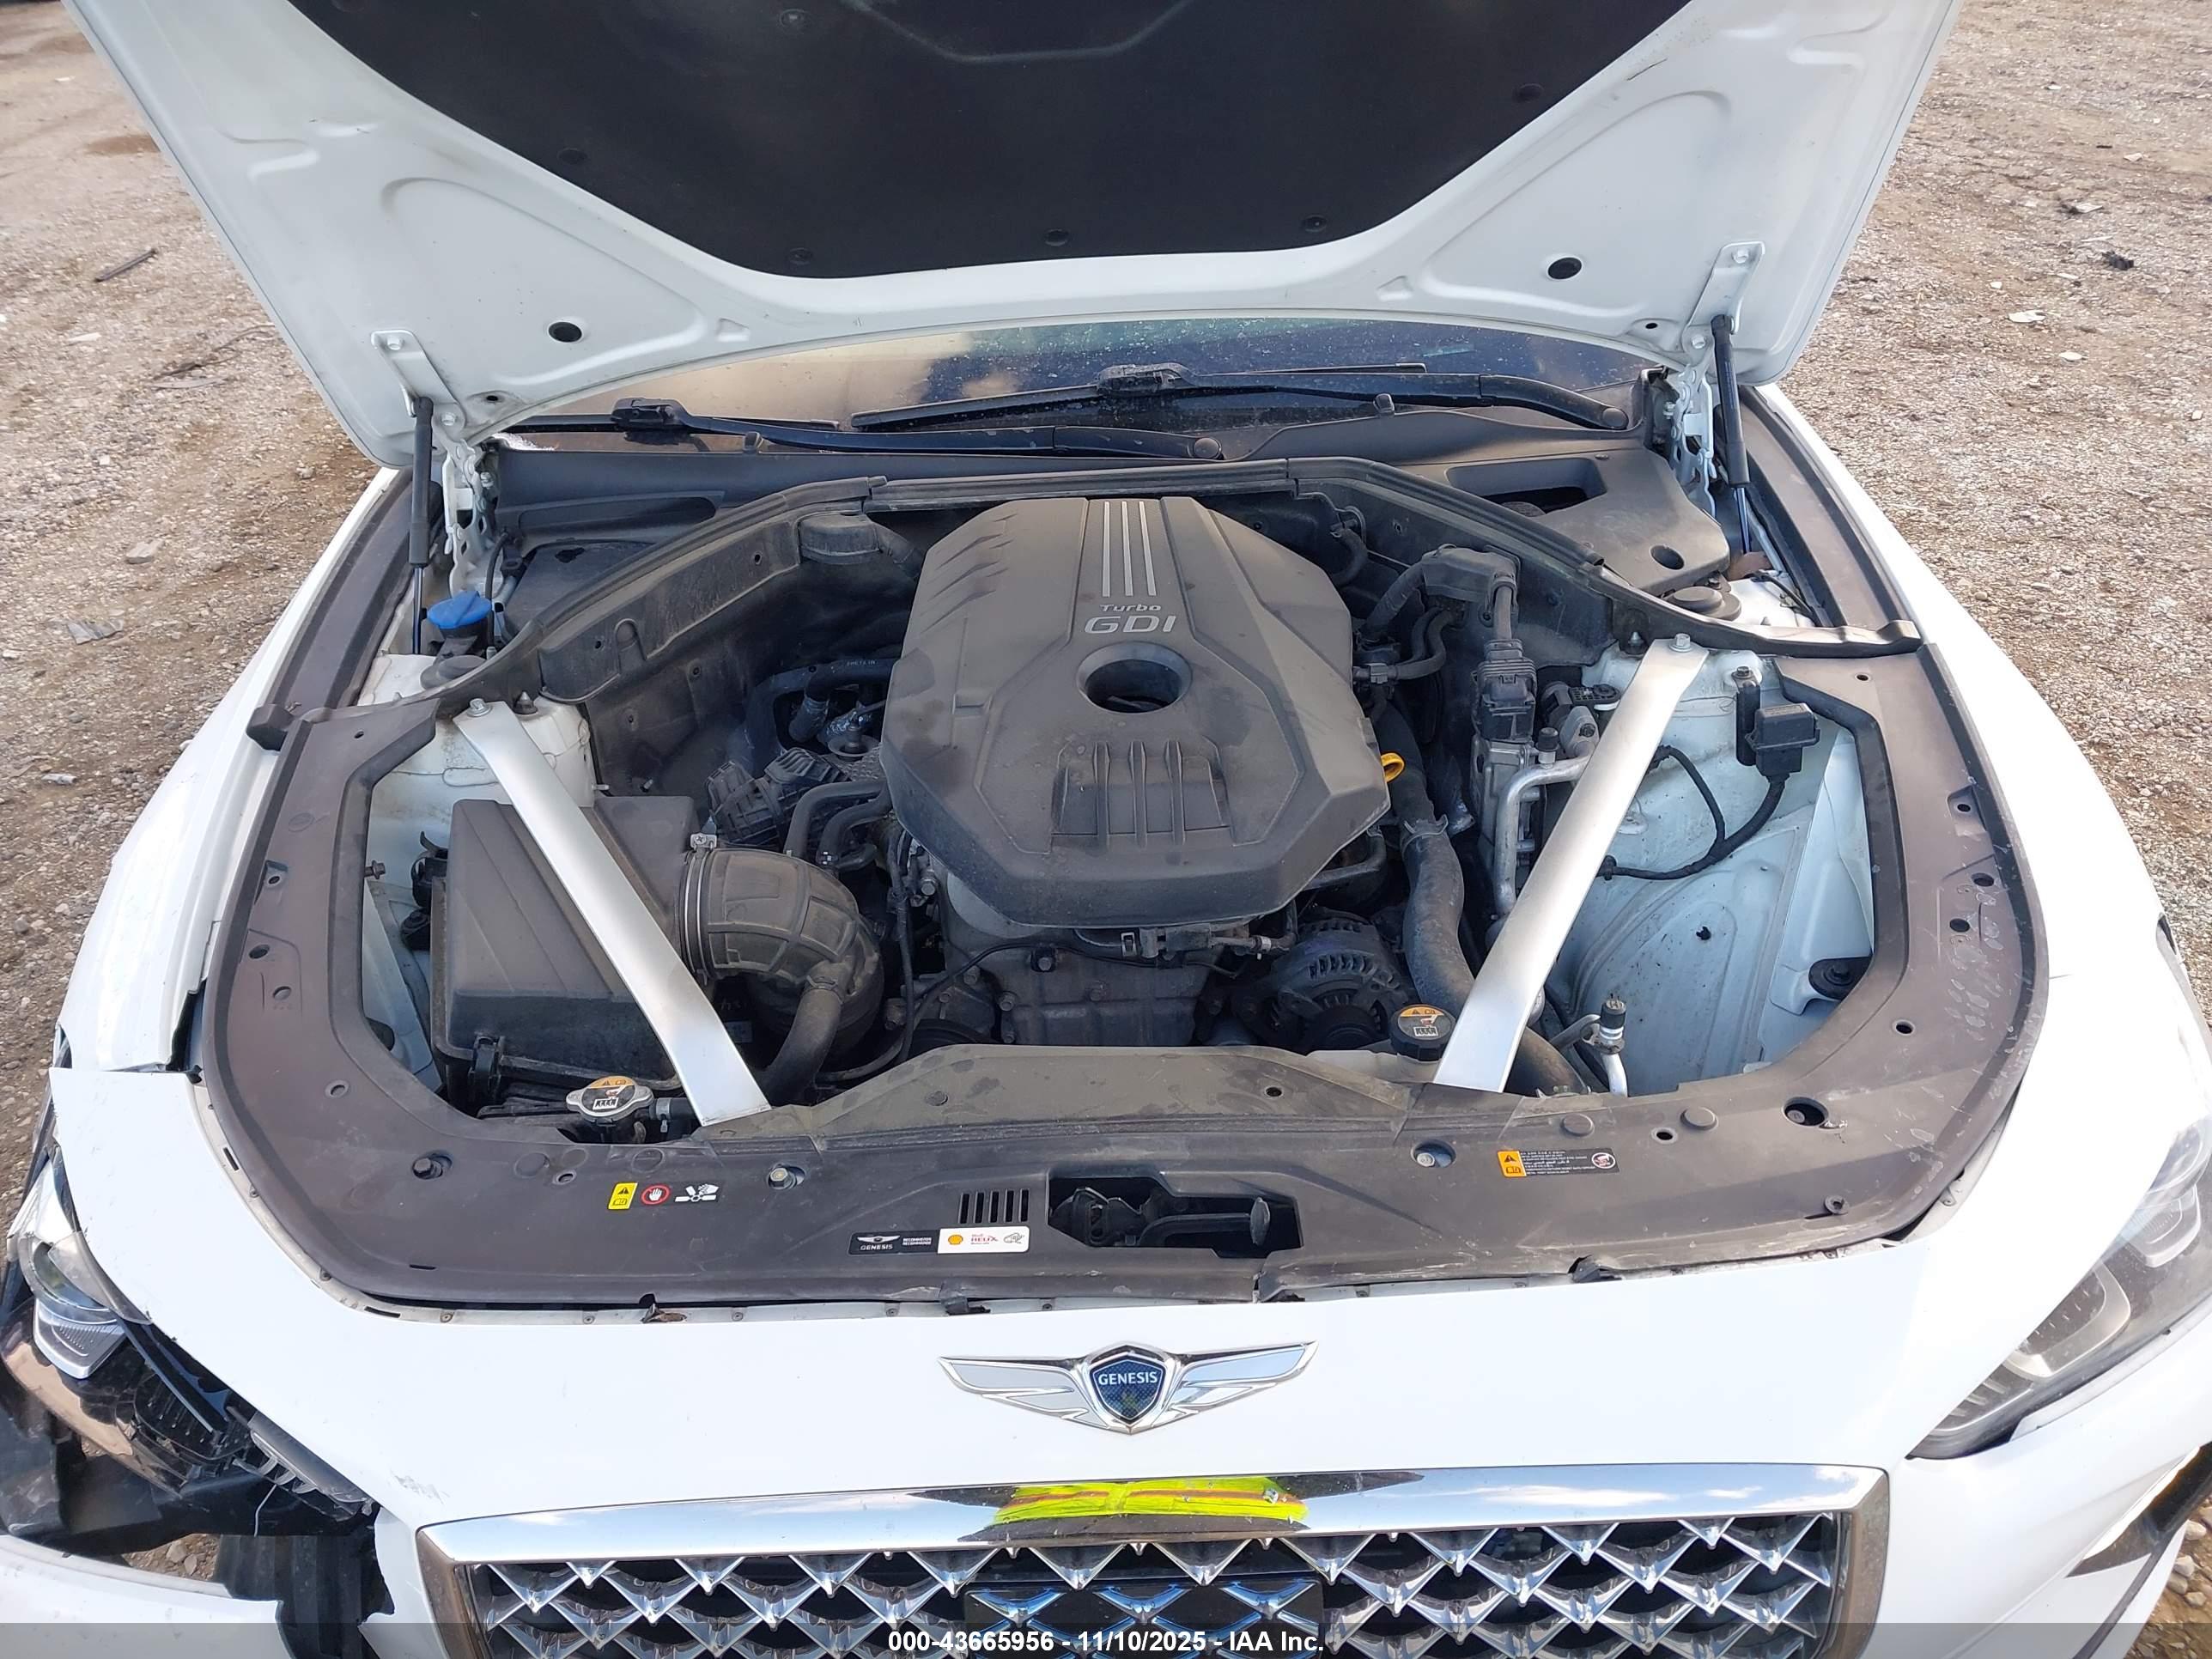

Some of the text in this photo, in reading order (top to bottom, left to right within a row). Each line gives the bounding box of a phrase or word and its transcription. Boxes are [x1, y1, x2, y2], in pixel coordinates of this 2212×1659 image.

[1100, 604, 1162, 612] Turbo
[1085, 615, 1176, 634] GDI
[1098, 1371, 1158, 1385] GENESIS
